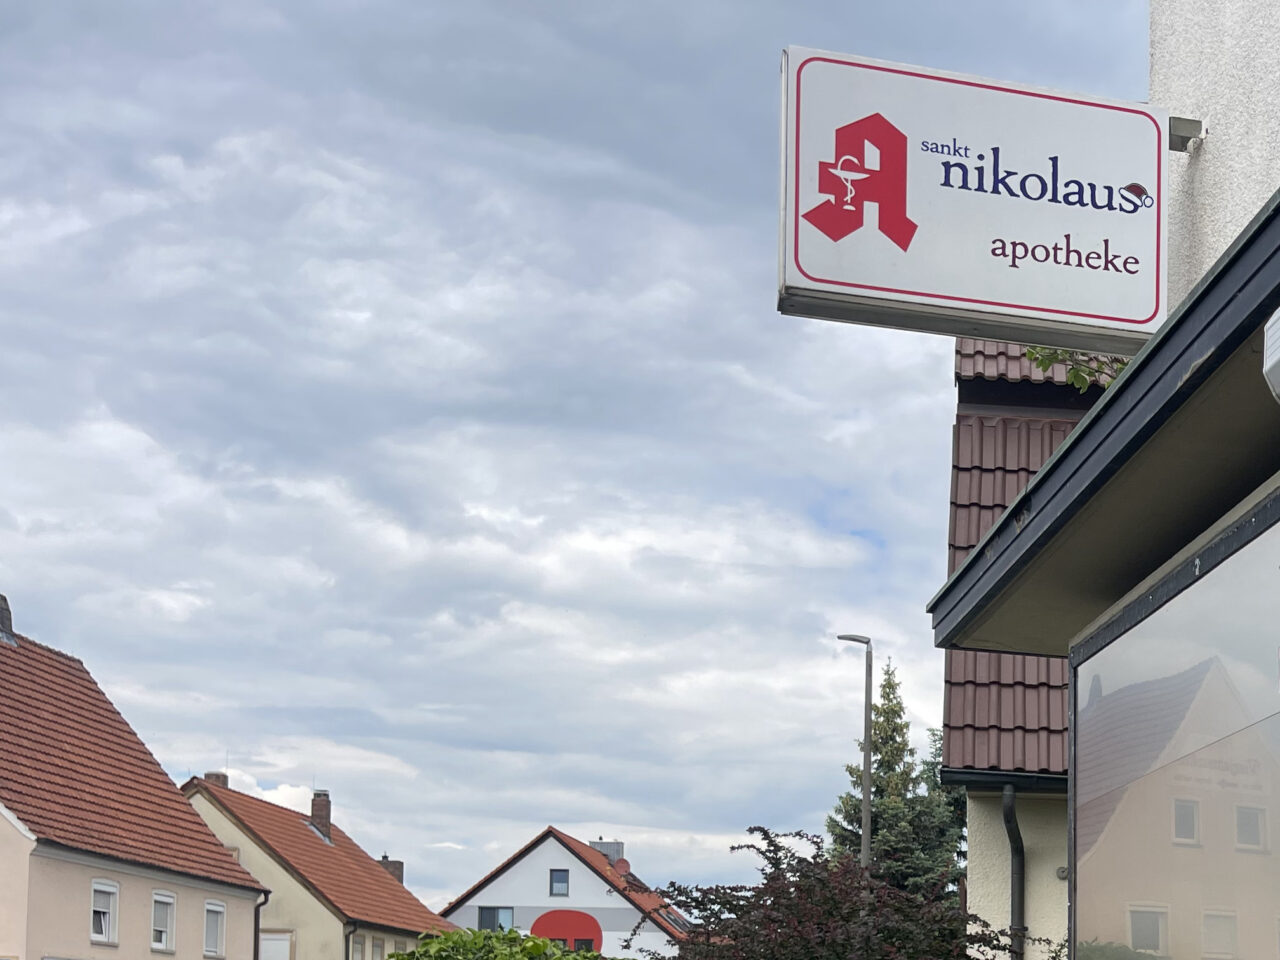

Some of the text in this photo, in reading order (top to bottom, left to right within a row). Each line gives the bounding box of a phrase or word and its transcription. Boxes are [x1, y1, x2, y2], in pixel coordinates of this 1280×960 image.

[920, 138, 970, 158] sankt
[939, 146, 1141, 214] nikolaus
[991, 233, 1140, 274] apotheke
